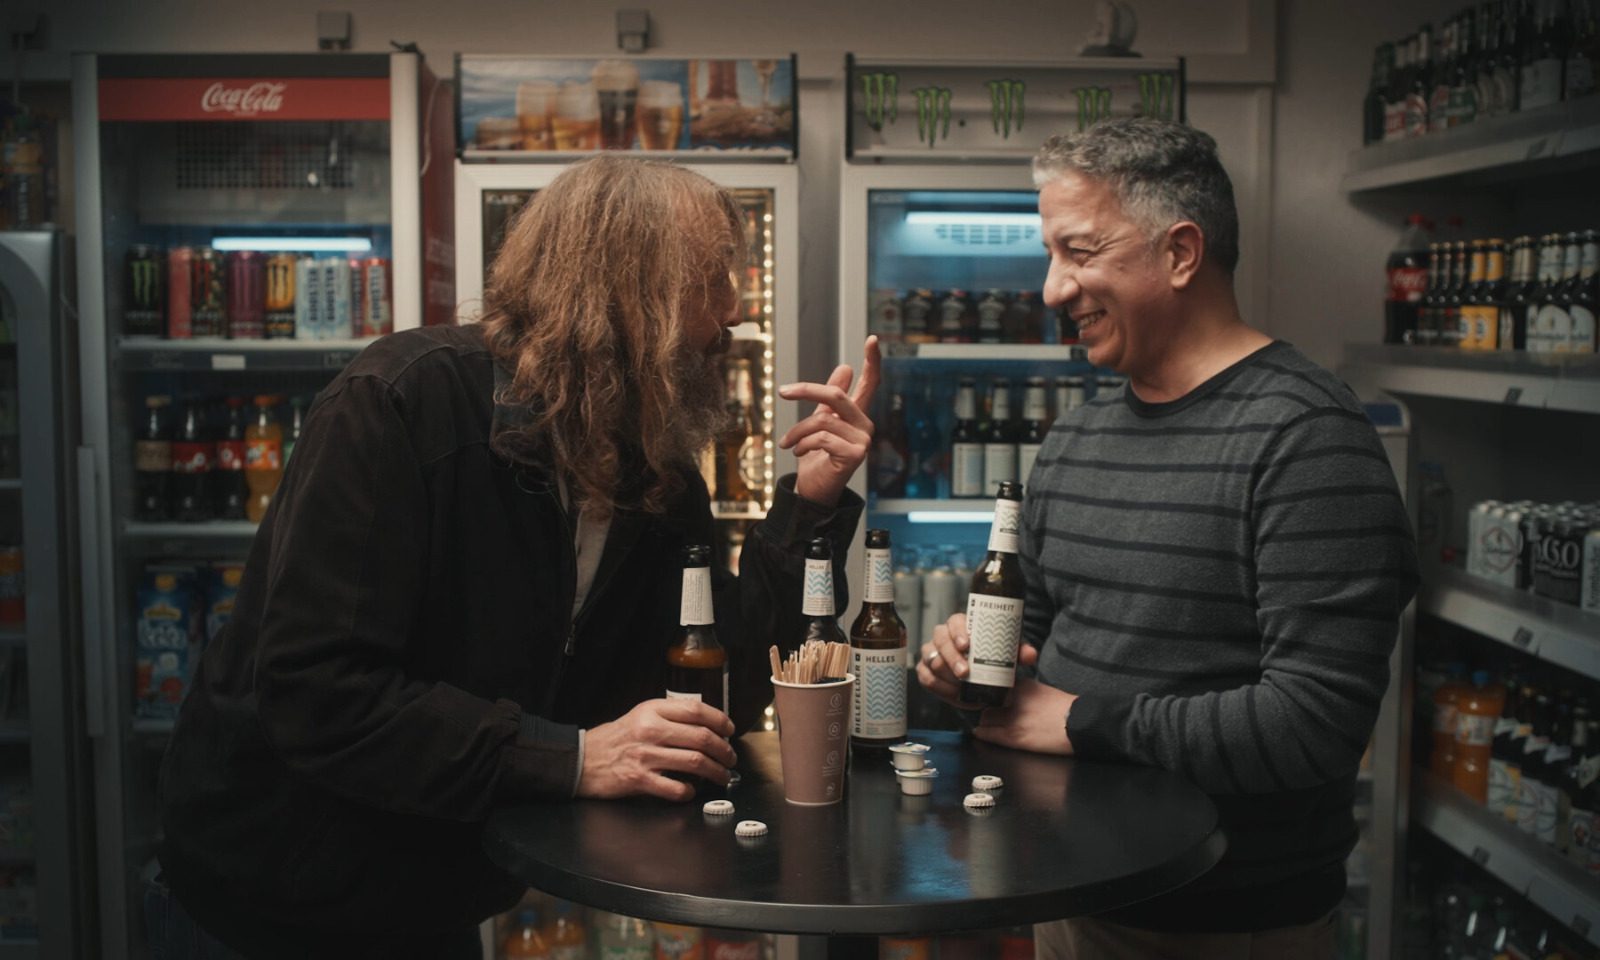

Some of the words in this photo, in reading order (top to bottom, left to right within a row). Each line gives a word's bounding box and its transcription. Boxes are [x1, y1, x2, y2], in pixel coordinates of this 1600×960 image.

[201, 82, 287, 113] Coca-Cola
[980, 601, 1015, 612] FREIHEIT
[865, 655, 896, 663] HELLES
